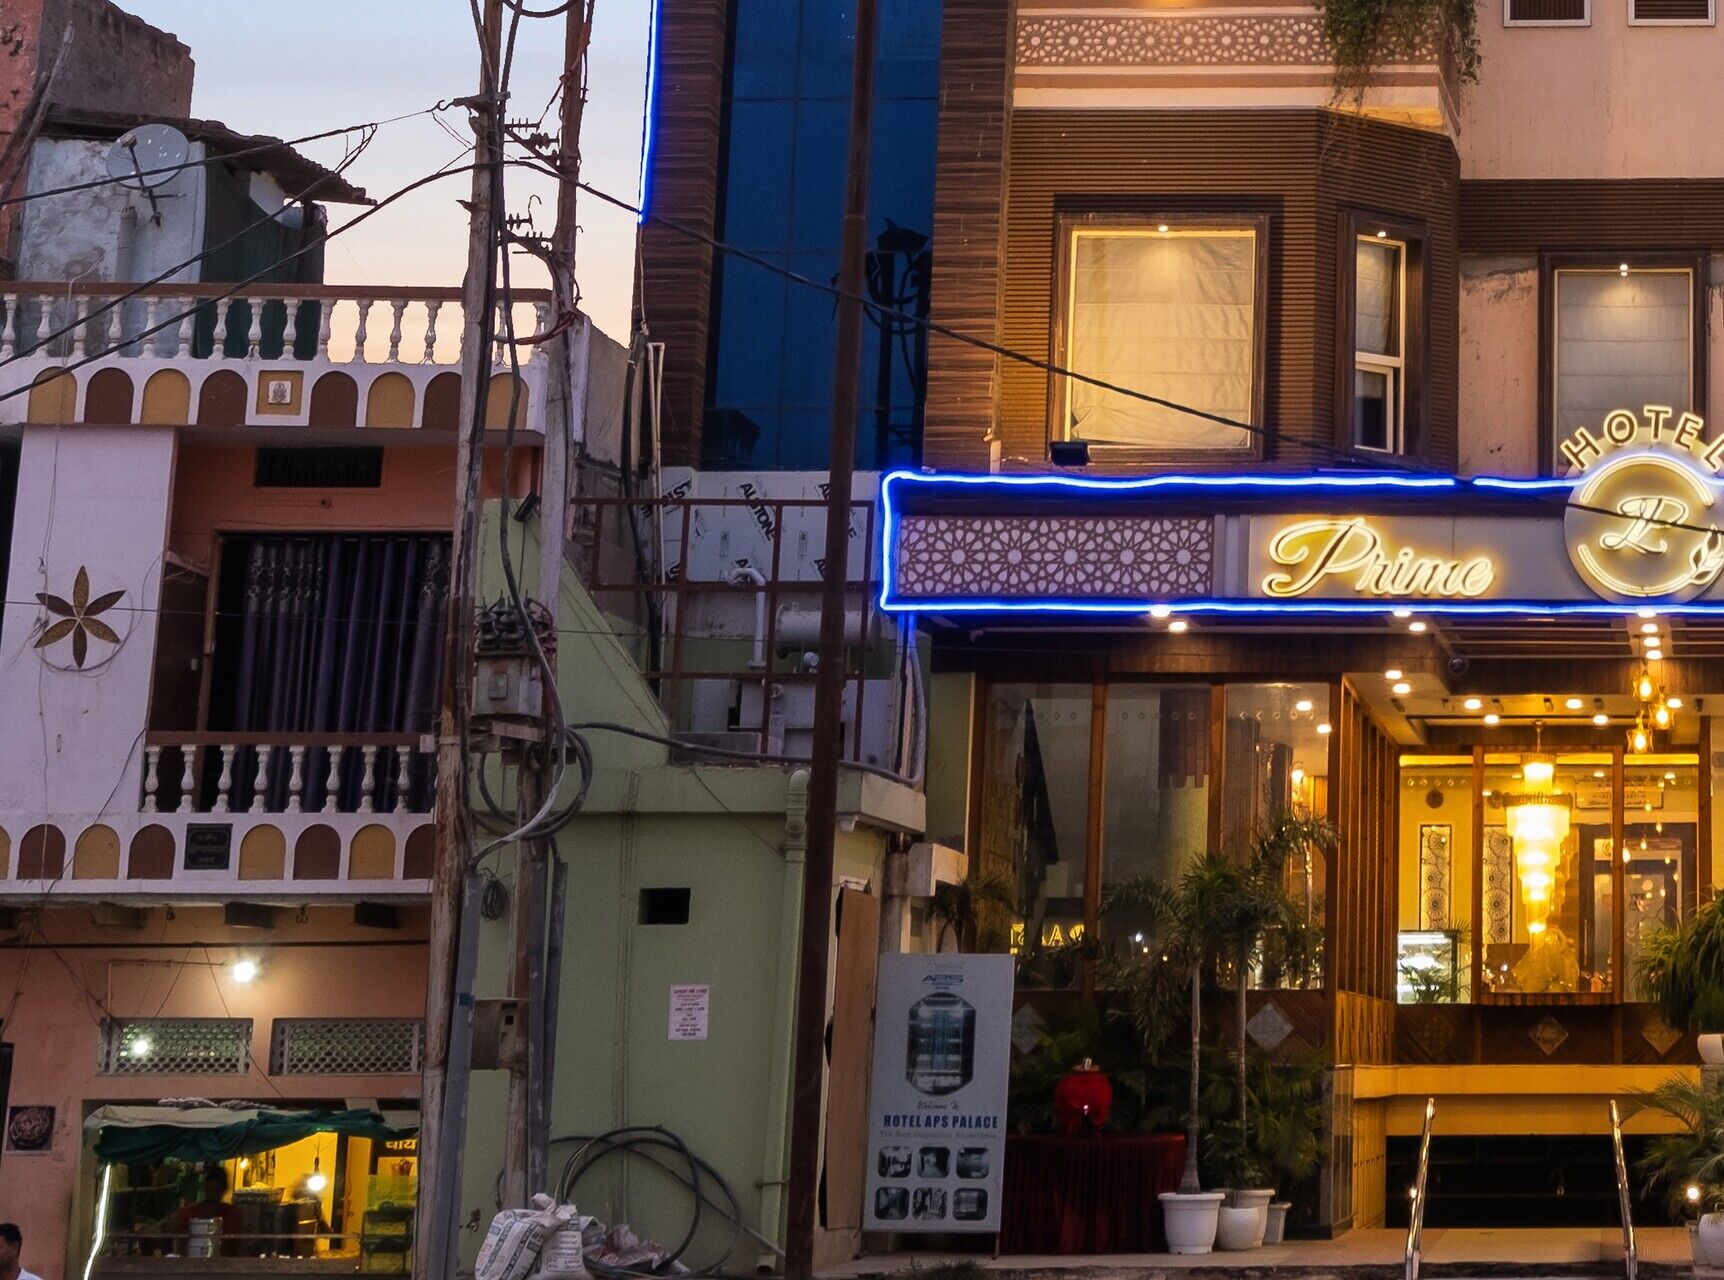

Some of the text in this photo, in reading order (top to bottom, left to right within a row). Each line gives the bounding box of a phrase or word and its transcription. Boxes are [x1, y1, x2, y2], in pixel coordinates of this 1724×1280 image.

[1262, 517, 1494, 597] Prime
[883, 1114, 998, 1129] HOTEL APS PALACE
